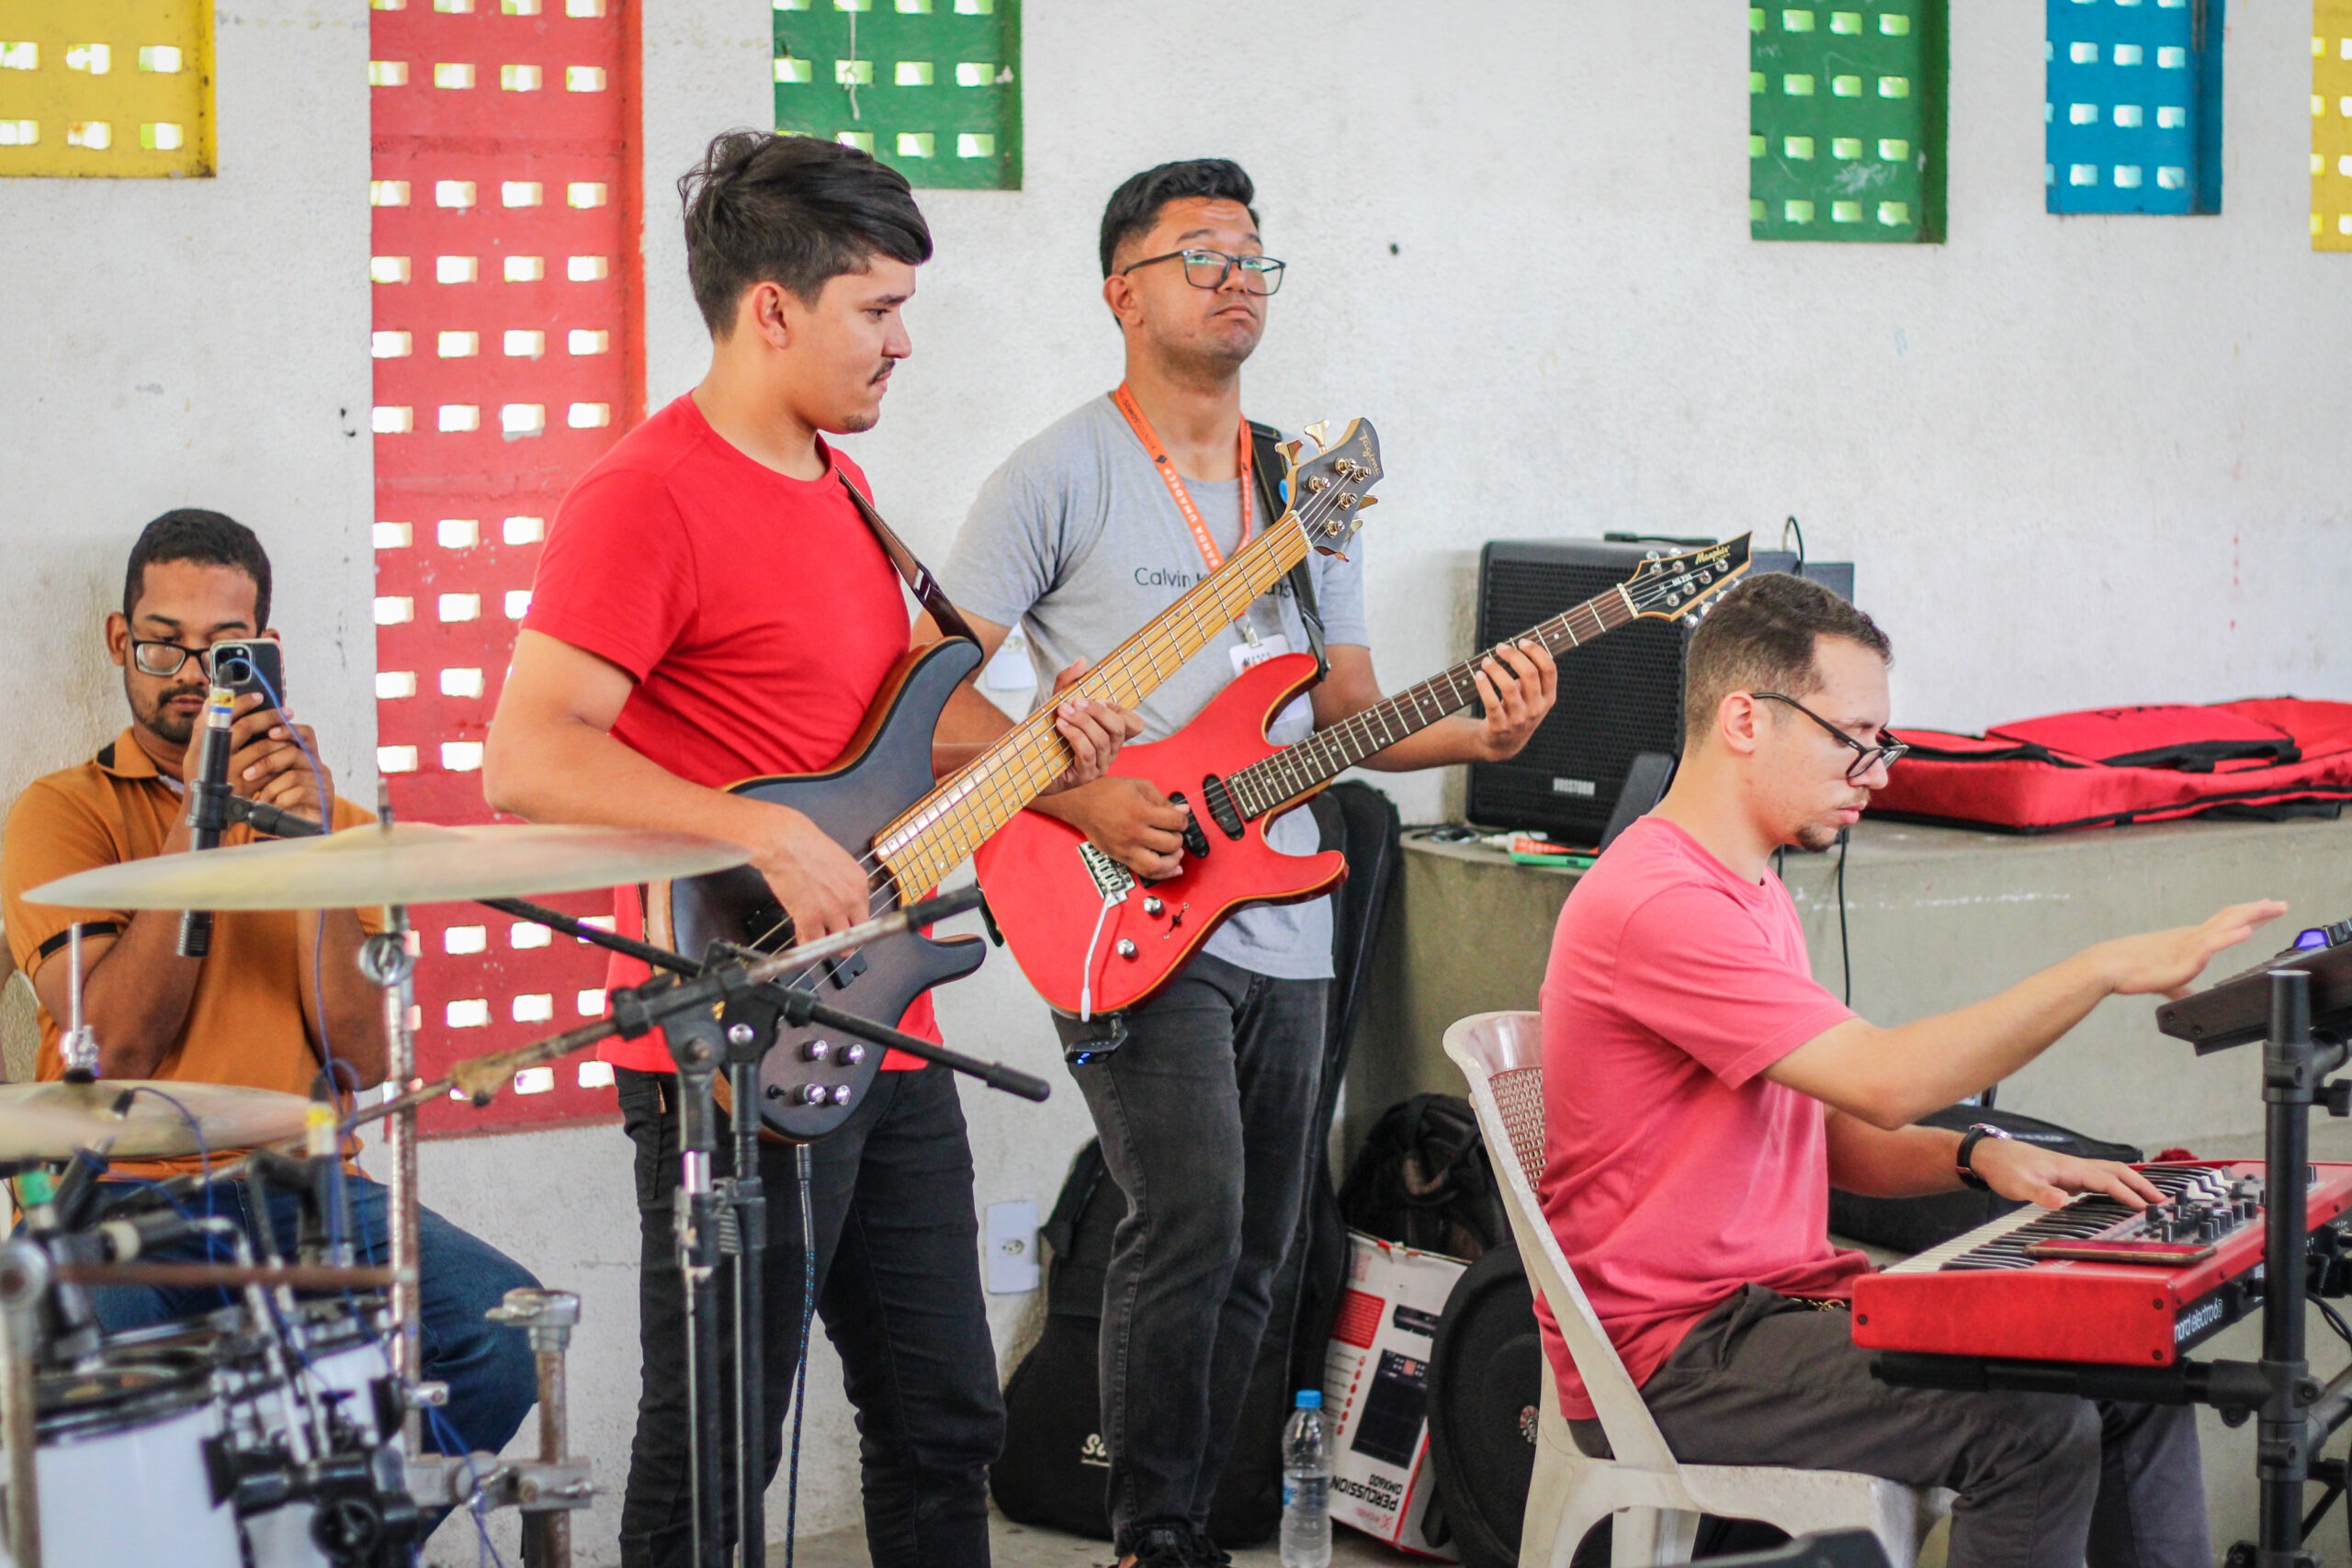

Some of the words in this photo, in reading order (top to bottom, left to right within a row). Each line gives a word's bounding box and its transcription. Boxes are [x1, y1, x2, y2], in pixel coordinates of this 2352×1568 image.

[1359, 427, 1380, 476] Tagima
[1163, 468, 1198, 523] UMADECP
[1194, 526, 1220, 568] BANDA
[1135, 568, 1193, 588] Calvin
[2175, 1314, 2190, 1344] nord
[1329, 1474, 1399, 1512] PERCUSSION
